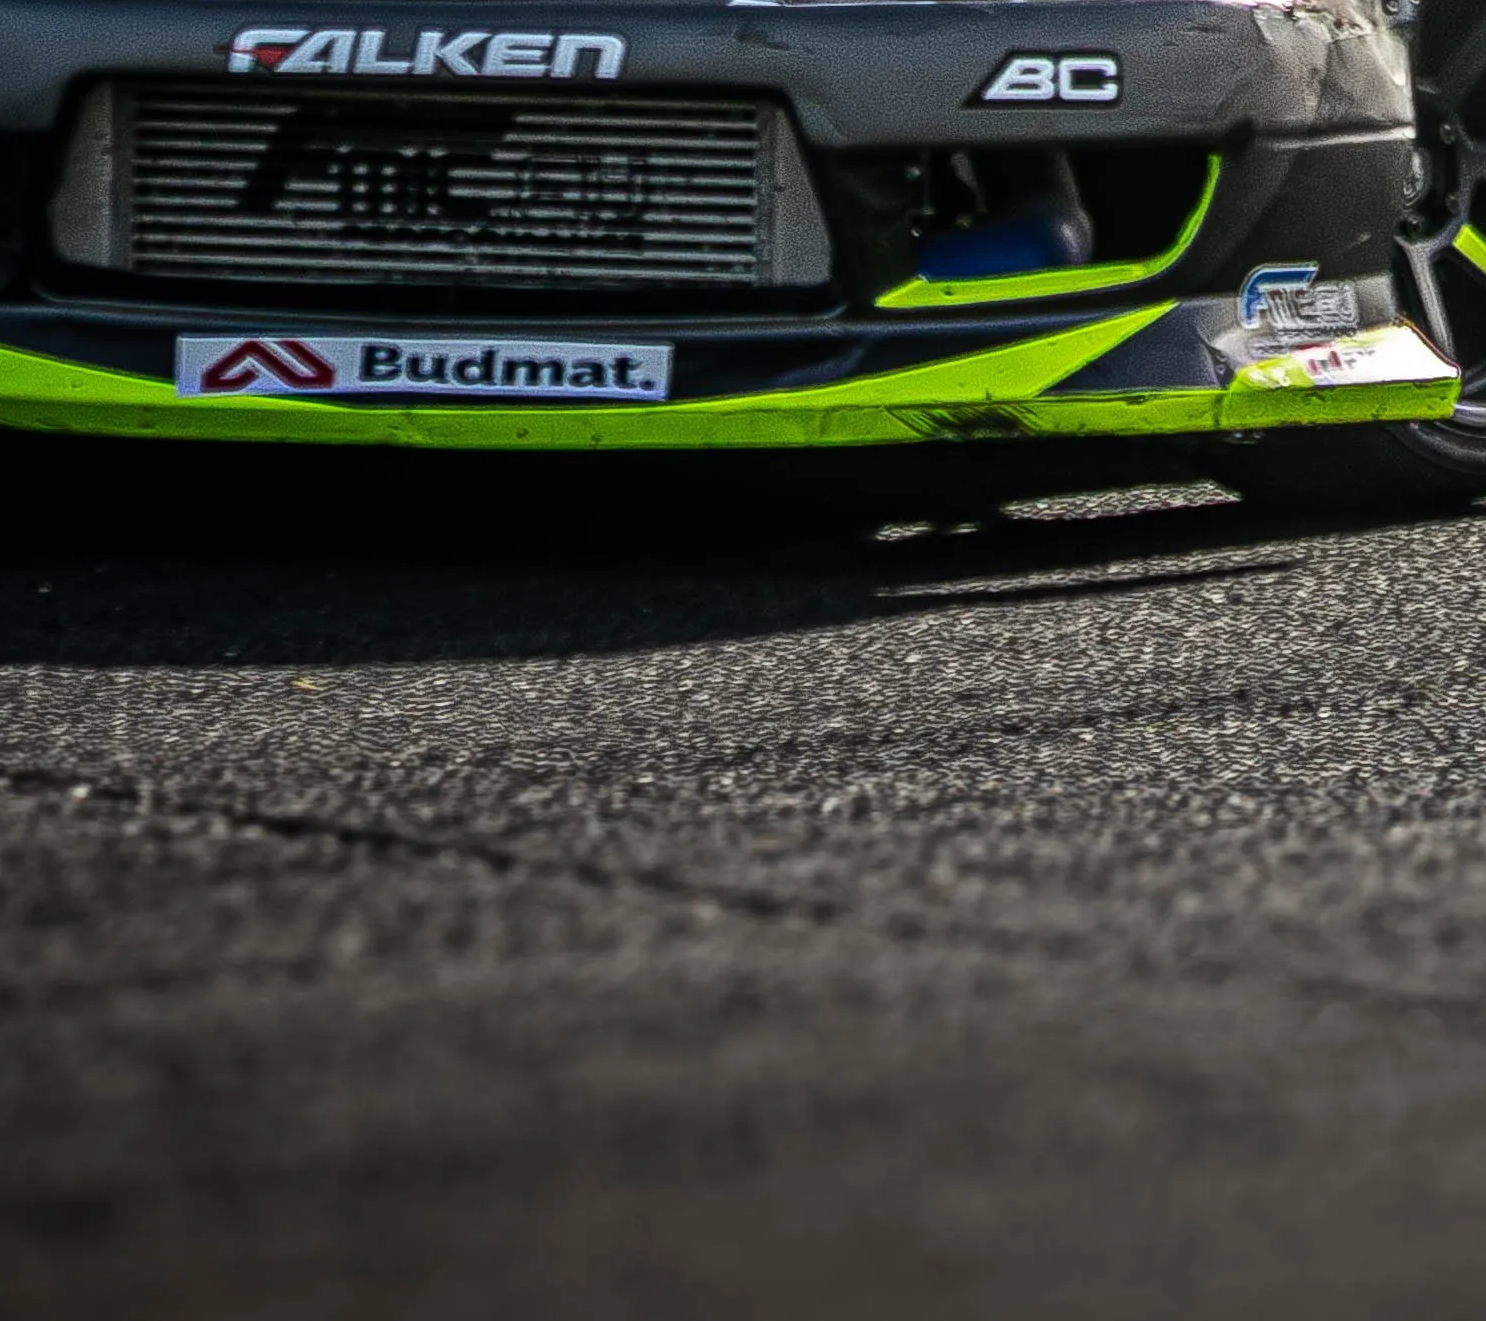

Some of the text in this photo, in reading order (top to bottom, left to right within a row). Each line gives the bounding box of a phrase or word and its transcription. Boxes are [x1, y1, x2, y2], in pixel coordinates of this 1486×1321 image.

[226, 28, 626, 79] FALKEN
[983, 59, 1118, 100] BC
[357, 344, 656, 391] Budmat.
